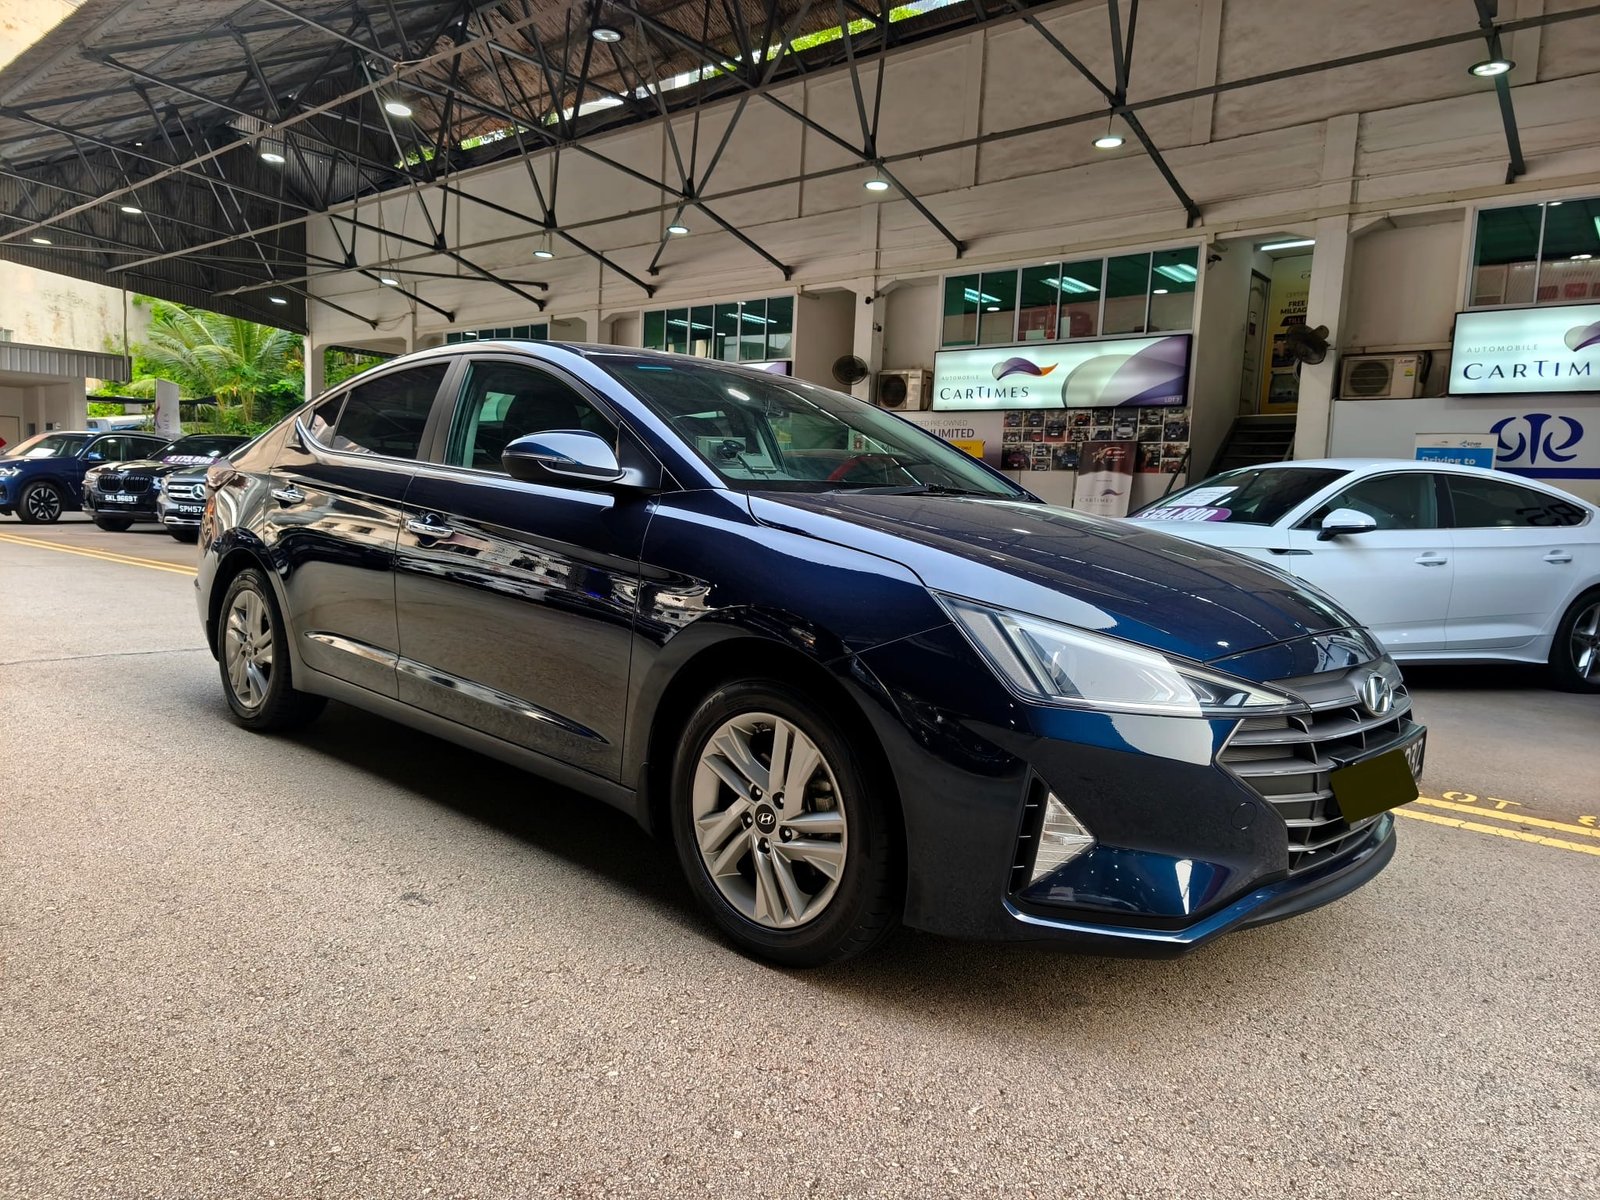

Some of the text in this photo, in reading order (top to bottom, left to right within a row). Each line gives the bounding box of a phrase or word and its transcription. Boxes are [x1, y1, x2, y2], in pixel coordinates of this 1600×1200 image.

[1466, 344, 1538, 353] AUTOMOBILE
[940, 386, 1029, 400] CARTIMES
[1464, 457, 1476, 465] to
